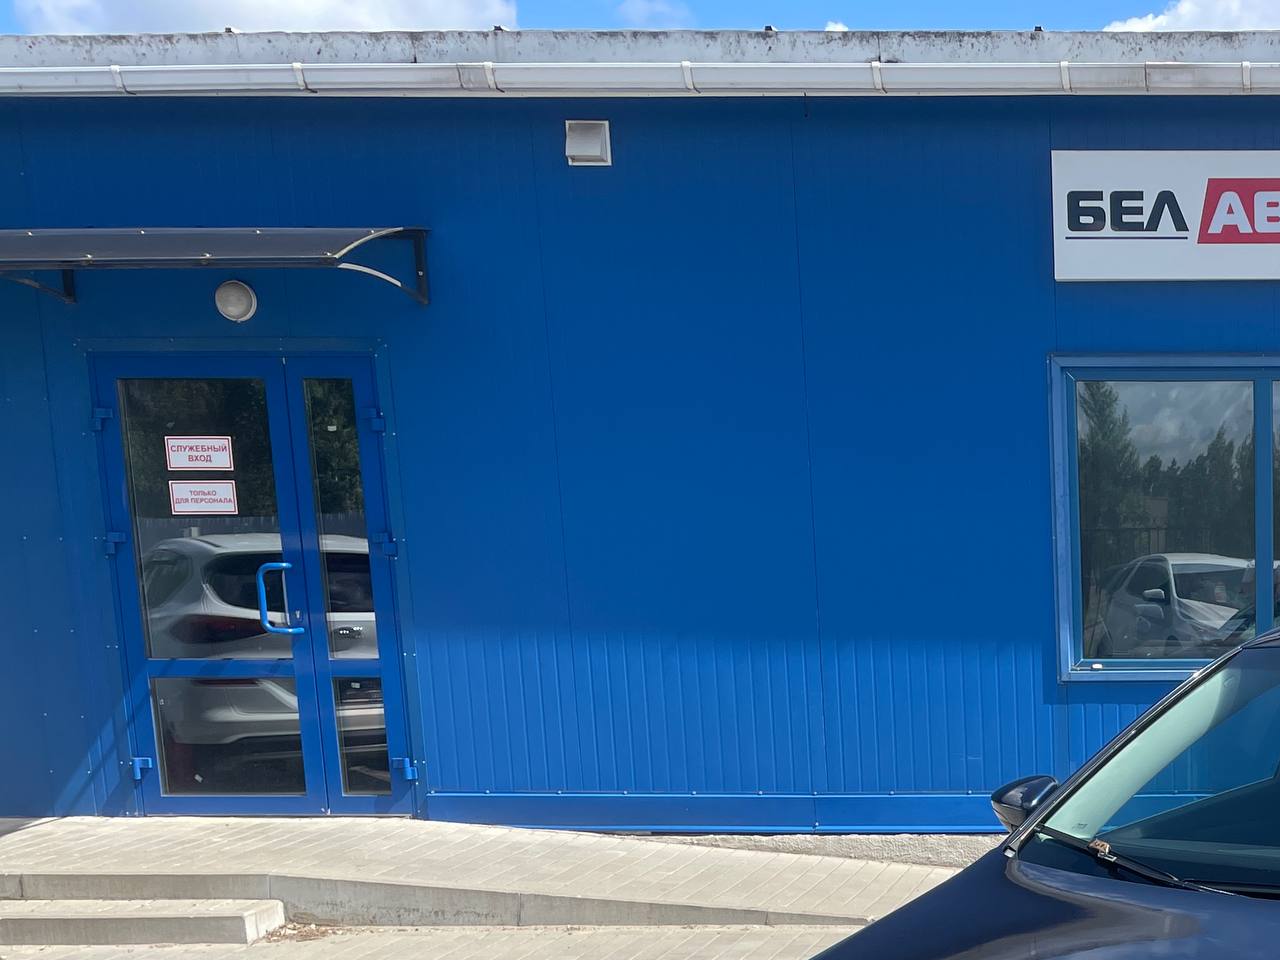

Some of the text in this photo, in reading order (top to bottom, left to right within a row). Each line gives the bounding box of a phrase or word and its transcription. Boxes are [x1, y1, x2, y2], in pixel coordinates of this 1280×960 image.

[1067, 189, 1190, 232] БЕЛ
[170, 444, 228, 453] СЛУЖЕБНЫЙ
[188, 454, 212, 463] ВХОД
